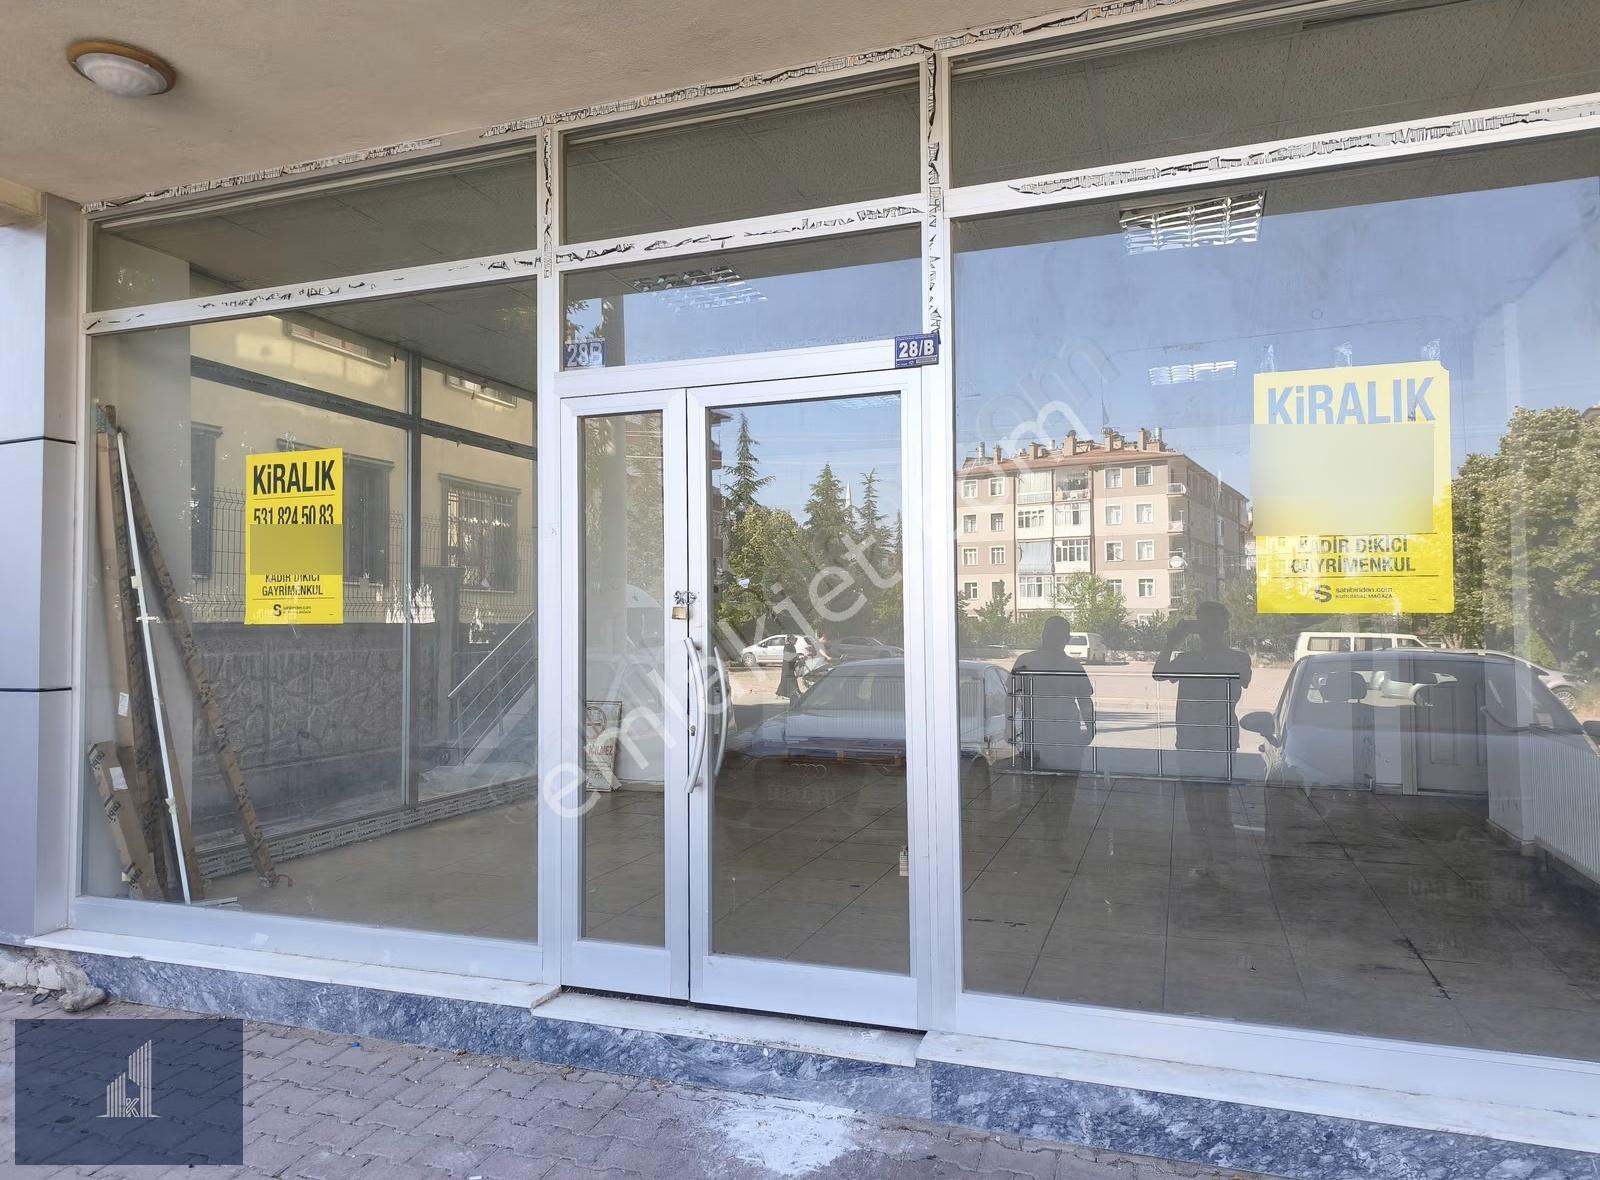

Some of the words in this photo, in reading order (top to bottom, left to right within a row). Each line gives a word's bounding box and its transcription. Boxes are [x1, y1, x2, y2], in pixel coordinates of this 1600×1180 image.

[899, 340, 935, 358] 28/B
[254, 507, 273, 524] 531
[278, 506, 298, 524] 824
[319, 504, 334, 524] 83
